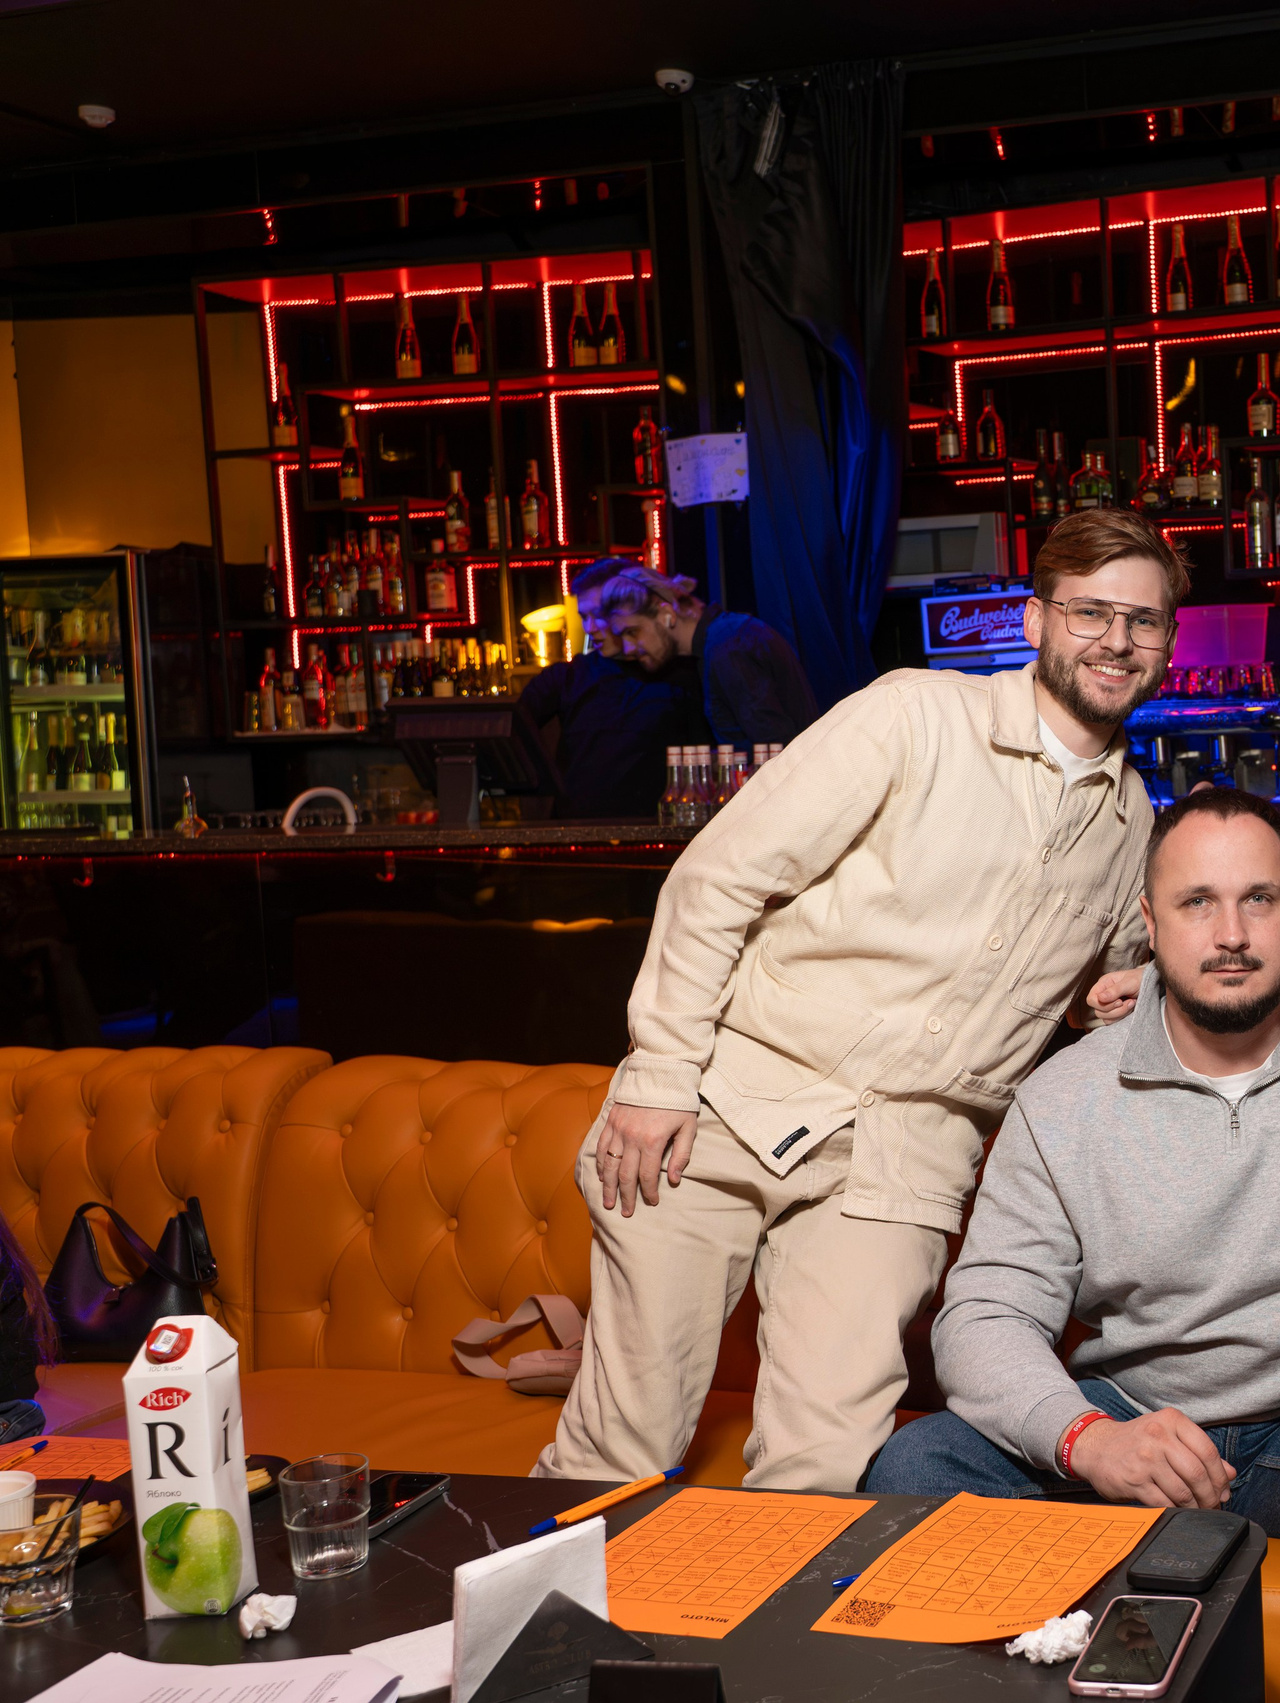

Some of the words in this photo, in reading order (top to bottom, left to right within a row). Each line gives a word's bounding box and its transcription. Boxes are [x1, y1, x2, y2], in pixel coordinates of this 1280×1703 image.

[980, 622, 1025, 641] Budva
[146, 1391, 185, 1408] Rich
[142, 1421, 198, 1480] R
[146, 1489, 182, 1498] Яблоко
[1150, 1559, 1198, 1569] 19:53
[680, 1613, 730, 1623] MIXLOTO
